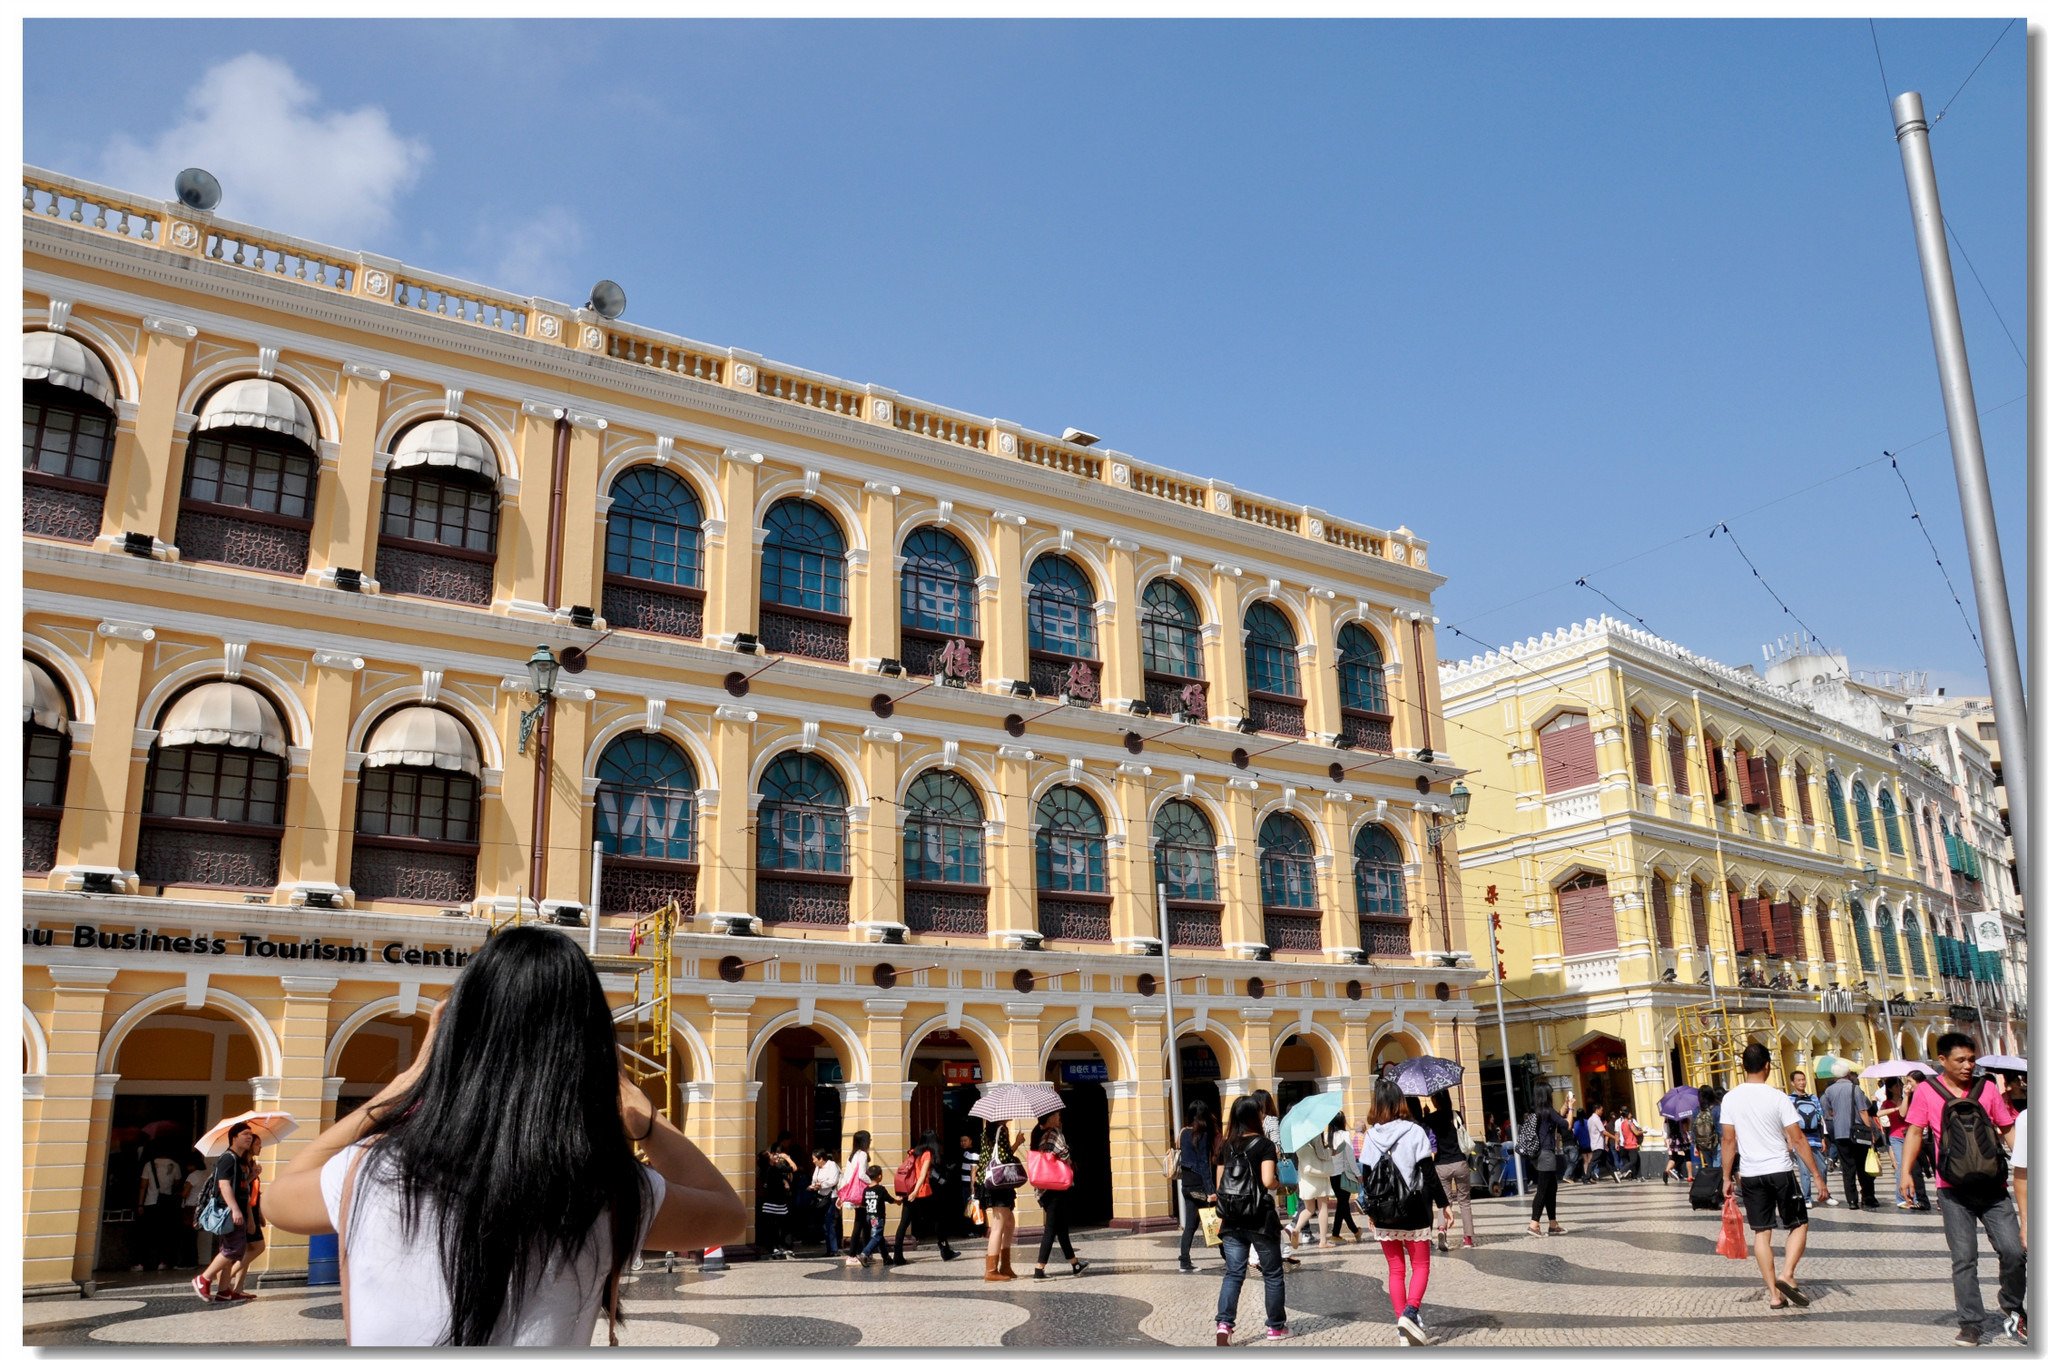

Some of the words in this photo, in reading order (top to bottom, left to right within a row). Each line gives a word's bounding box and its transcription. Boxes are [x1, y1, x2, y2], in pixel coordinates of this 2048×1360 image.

[945, 678, 968, 689] CASA
[23, 926, 54, 947] u
[73, 925, 226, 955] Business
[240, 935, 367, 963] Tourism
[382, 942, 476, 967] Centr
[1890, 1002, 1920, 1017] Levi's
